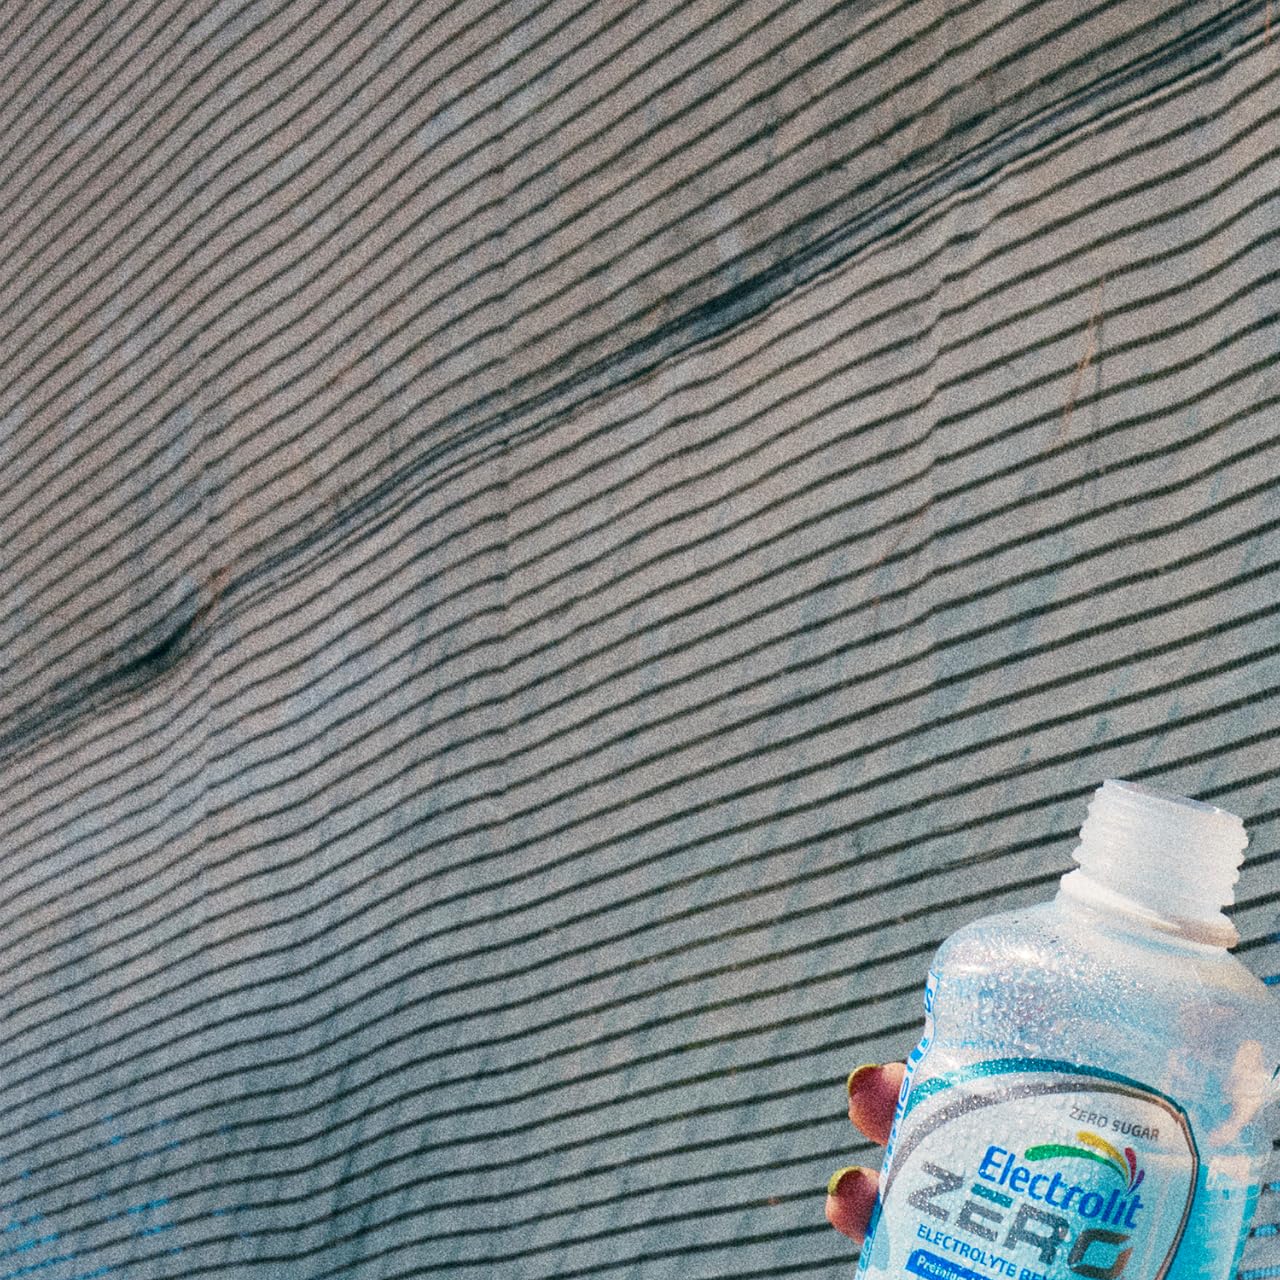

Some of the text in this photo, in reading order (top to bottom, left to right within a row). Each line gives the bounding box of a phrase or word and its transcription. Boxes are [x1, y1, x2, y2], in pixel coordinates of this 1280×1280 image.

[1069, 1106, 1160, 1141] ZERO SUGAR
[906, 1160, 1133, 1280] ZERO
[978, 1145, 1144, 1229] Electrolit
[916, 1223, 1016, 1277] ELECTROLYTE
